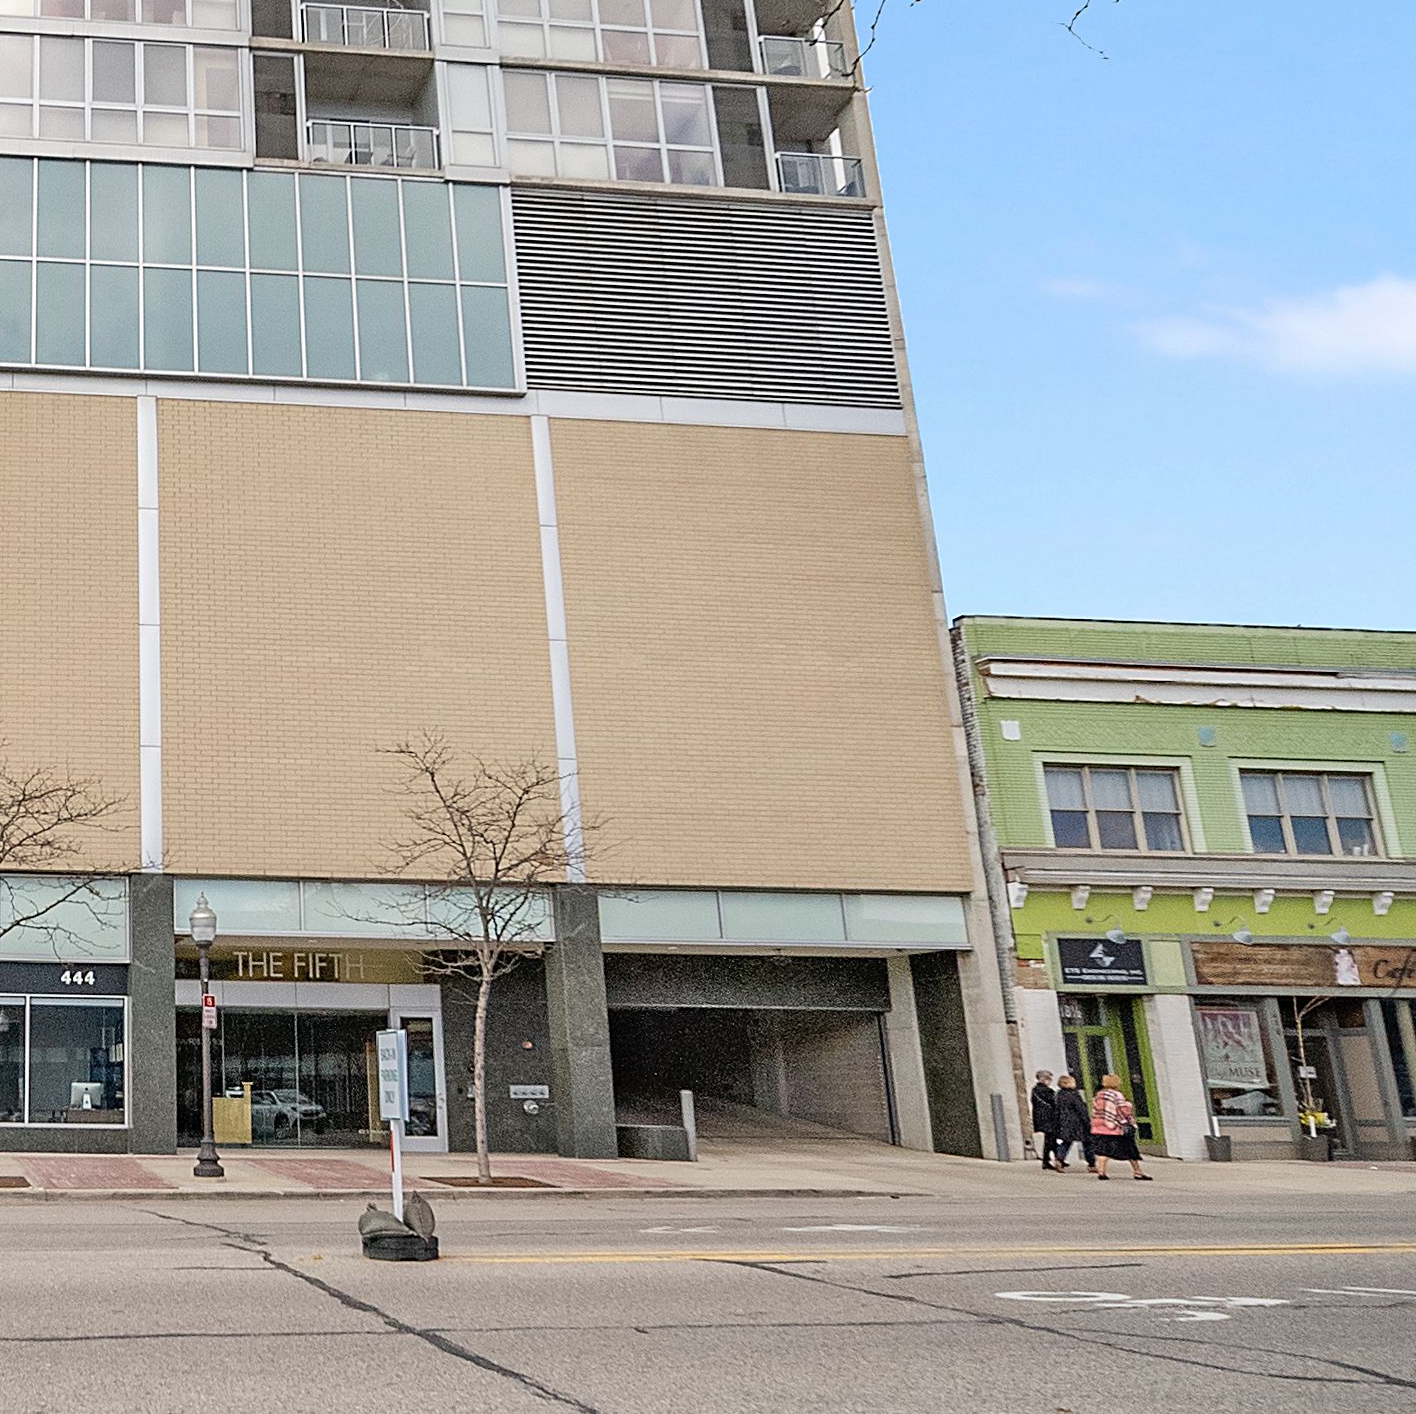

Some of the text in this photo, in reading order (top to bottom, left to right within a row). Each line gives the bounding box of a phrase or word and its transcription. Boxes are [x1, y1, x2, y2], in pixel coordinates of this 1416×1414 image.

[233, 951, 365, 980] THE FIFTH
[60, 970, 96, 986] 444
